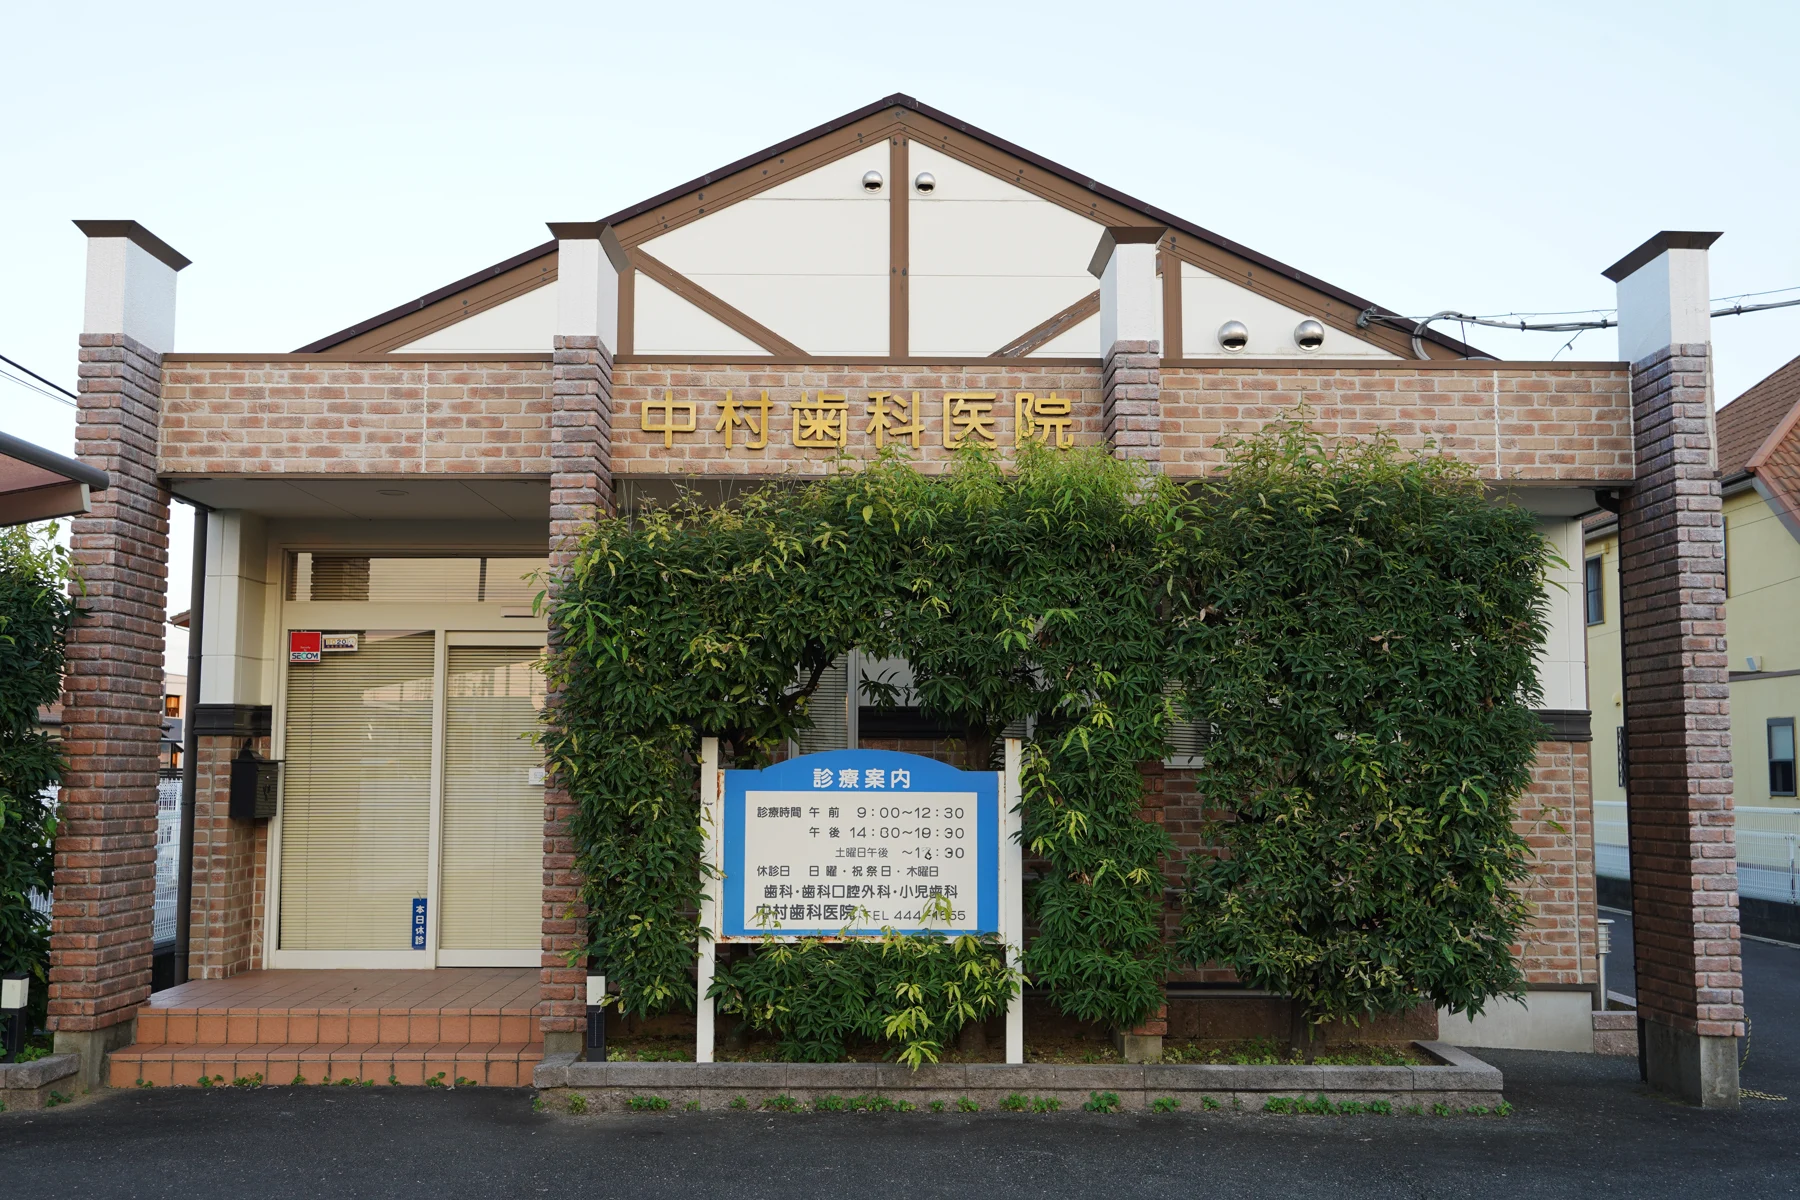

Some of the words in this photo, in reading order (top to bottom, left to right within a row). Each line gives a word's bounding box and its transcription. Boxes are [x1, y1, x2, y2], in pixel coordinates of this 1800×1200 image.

[641, 390, 1074, 449] 中村歯科医院
[291, 652, 319, 660] SECOM
[813, 768, 911, 789] 診療案内
[757, 806, 802, 818] 診療時間
[835, 847, 889, 858] 土曜日午後
[757, 865, 790, 877] 休診日
[415, 904, 425, 945] 本日休診
